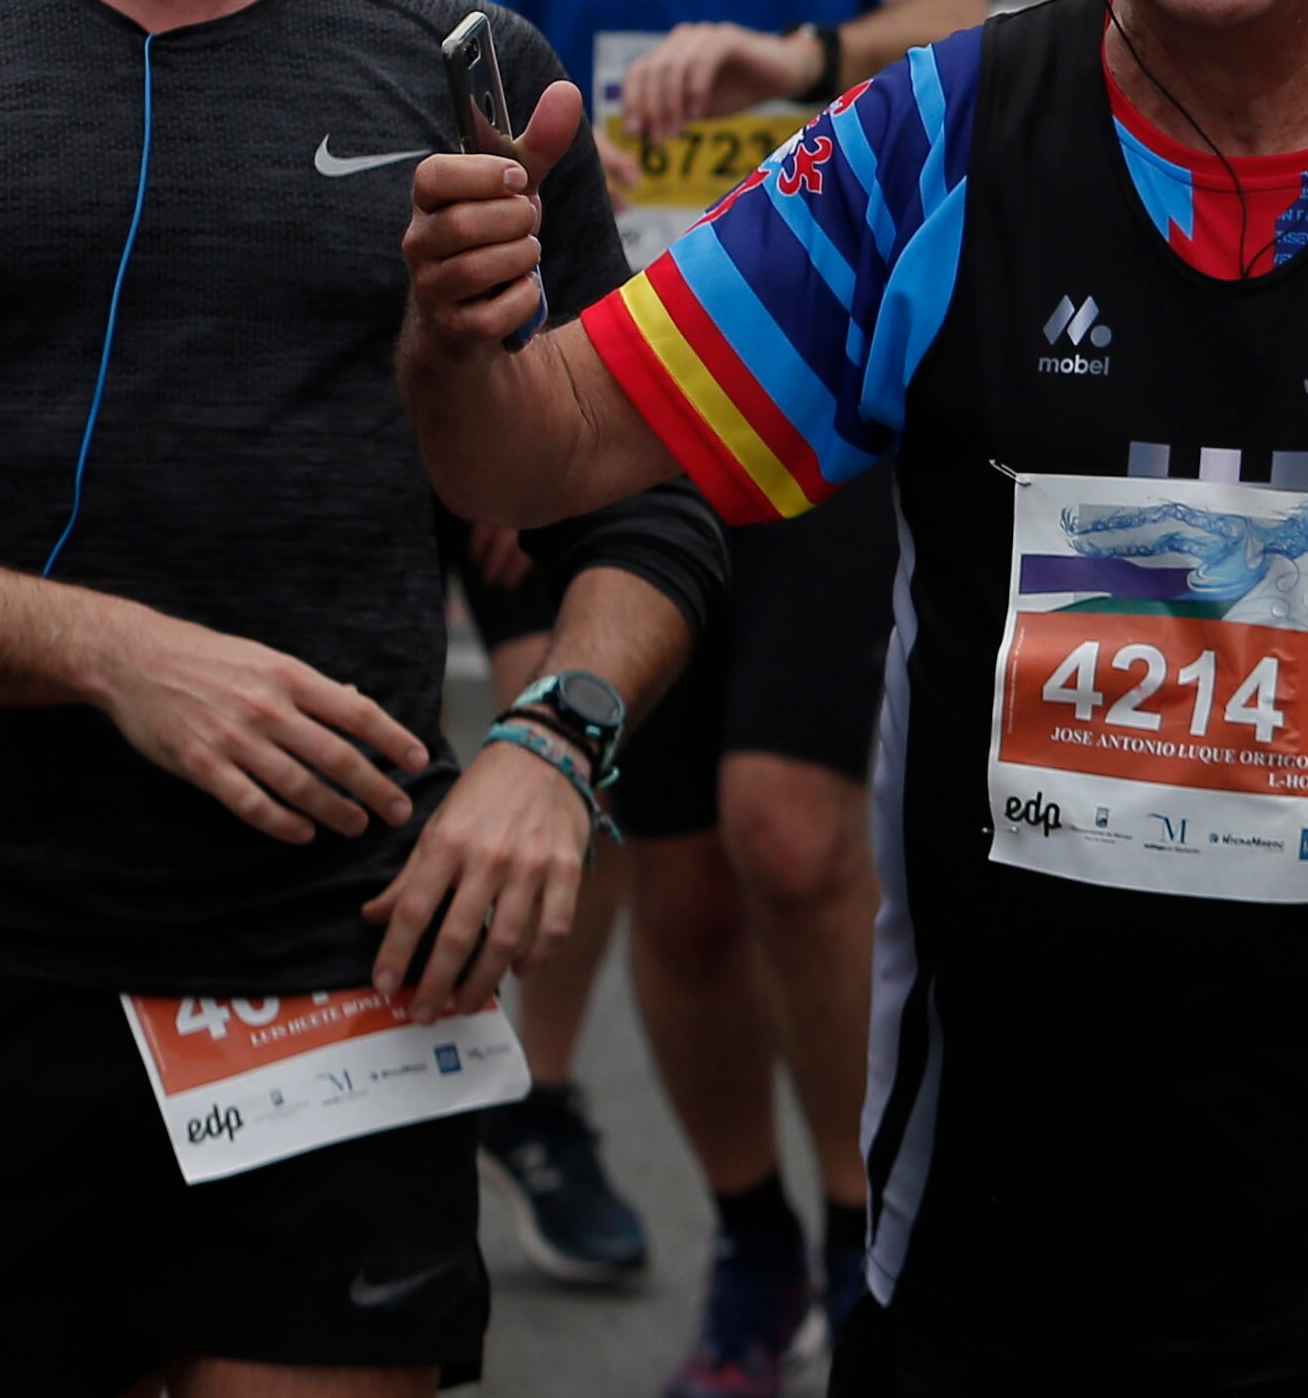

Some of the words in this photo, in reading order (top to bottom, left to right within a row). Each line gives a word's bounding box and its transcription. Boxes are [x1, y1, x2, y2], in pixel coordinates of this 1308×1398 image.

[1038, 354, 1109, 376] mobel
[1042, 639, 1285, 743] 4214
[1051, 726, 1092, 746] JOSE
[1096, 732, 1174, 756] ANTONIO
[1177, 743, 1235, 765] LUQUE
[1004, 791, 1062, 838] edp
[186, 1102, 244, 1143] edp
